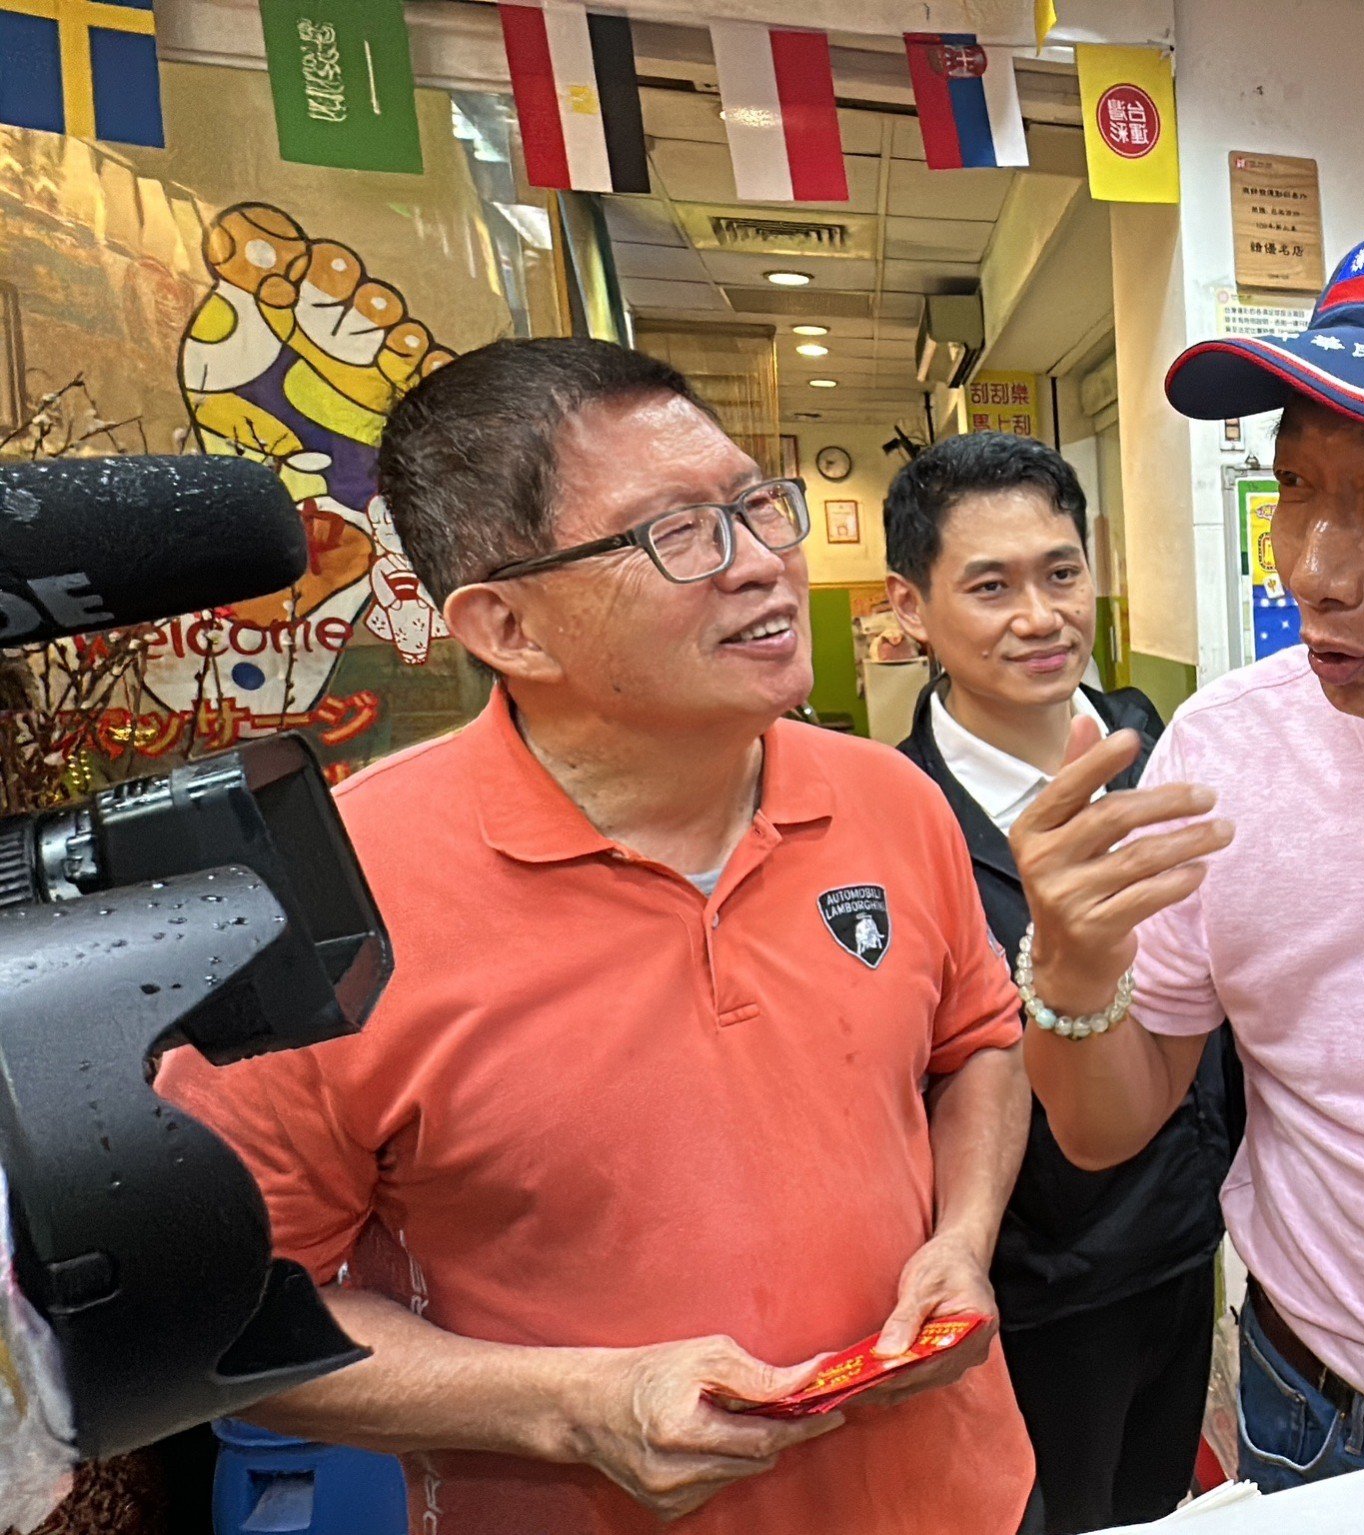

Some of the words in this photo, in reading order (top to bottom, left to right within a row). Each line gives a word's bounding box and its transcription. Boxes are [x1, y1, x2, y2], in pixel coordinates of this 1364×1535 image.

[970, 382, 1030, 405] 刮刮樂
[80, 617, 354, 660] elcome
